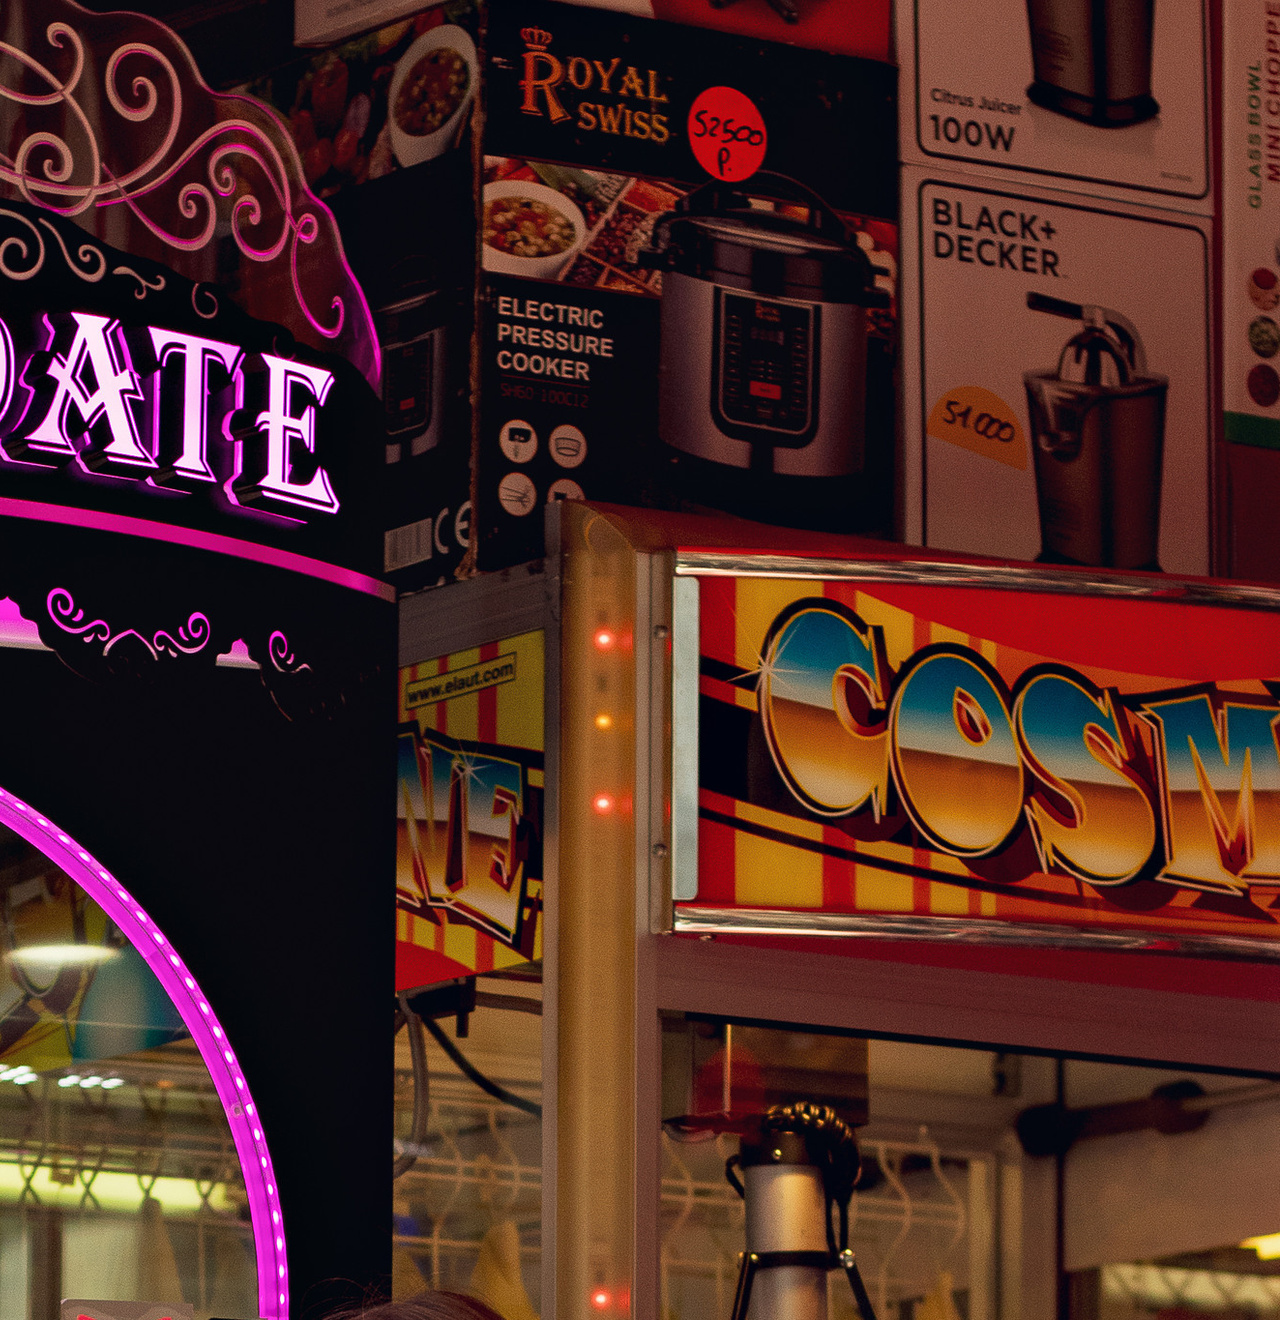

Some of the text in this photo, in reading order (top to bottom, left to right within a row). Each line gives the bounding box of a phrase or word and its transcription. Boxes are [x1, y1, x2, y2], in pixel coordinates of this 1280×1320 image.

[519, 50, 670, 125] ROYAL
[930, 88, 1022, 115] Citrus Juicer
[1247, 60, 1262, 126] BOWL
[577, 102, 670, 143] SWISS
[930, 114, 1015, 152] 100W
[933, 199, 1056, 241] BLACK+
[933, 232, 1060, 278] DECKER
[496, 295, 605, 330] ELECTRIC
[496, 323, 615, 359] PRESSURE
[496, 350, 590, 382] COOKER
[408, 663, 513, 703] www.elaut.com
